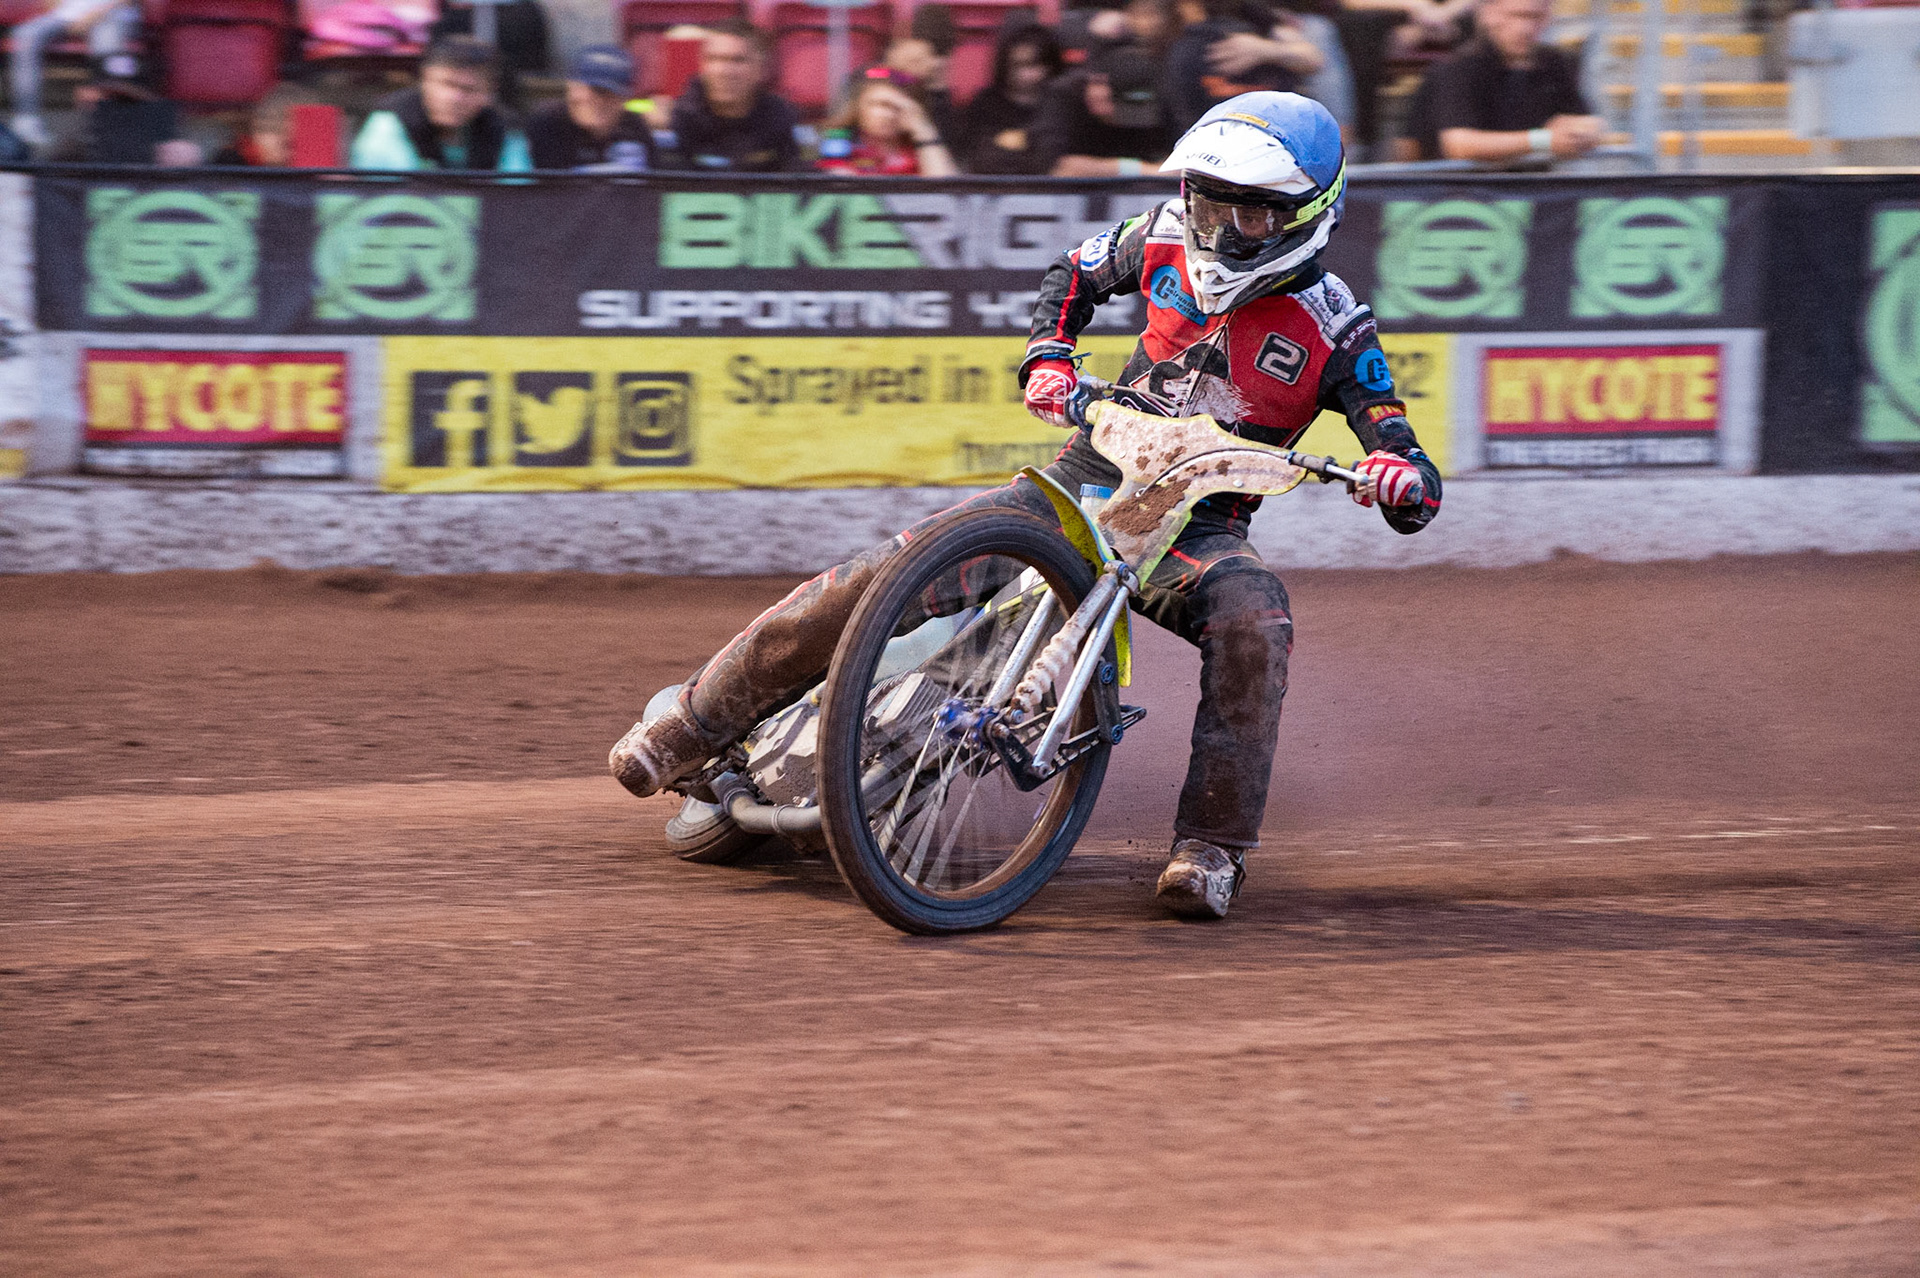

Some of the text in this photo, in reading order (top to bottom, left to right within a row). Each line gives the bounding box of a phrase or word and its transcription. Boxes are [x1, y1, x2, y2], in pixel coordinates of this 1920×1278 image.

[577, 289, 1136, 330] SUPPORTING YOR
[1261, 337, 1303, 380] 2
[724, 354, 931, 416] Sprayed
